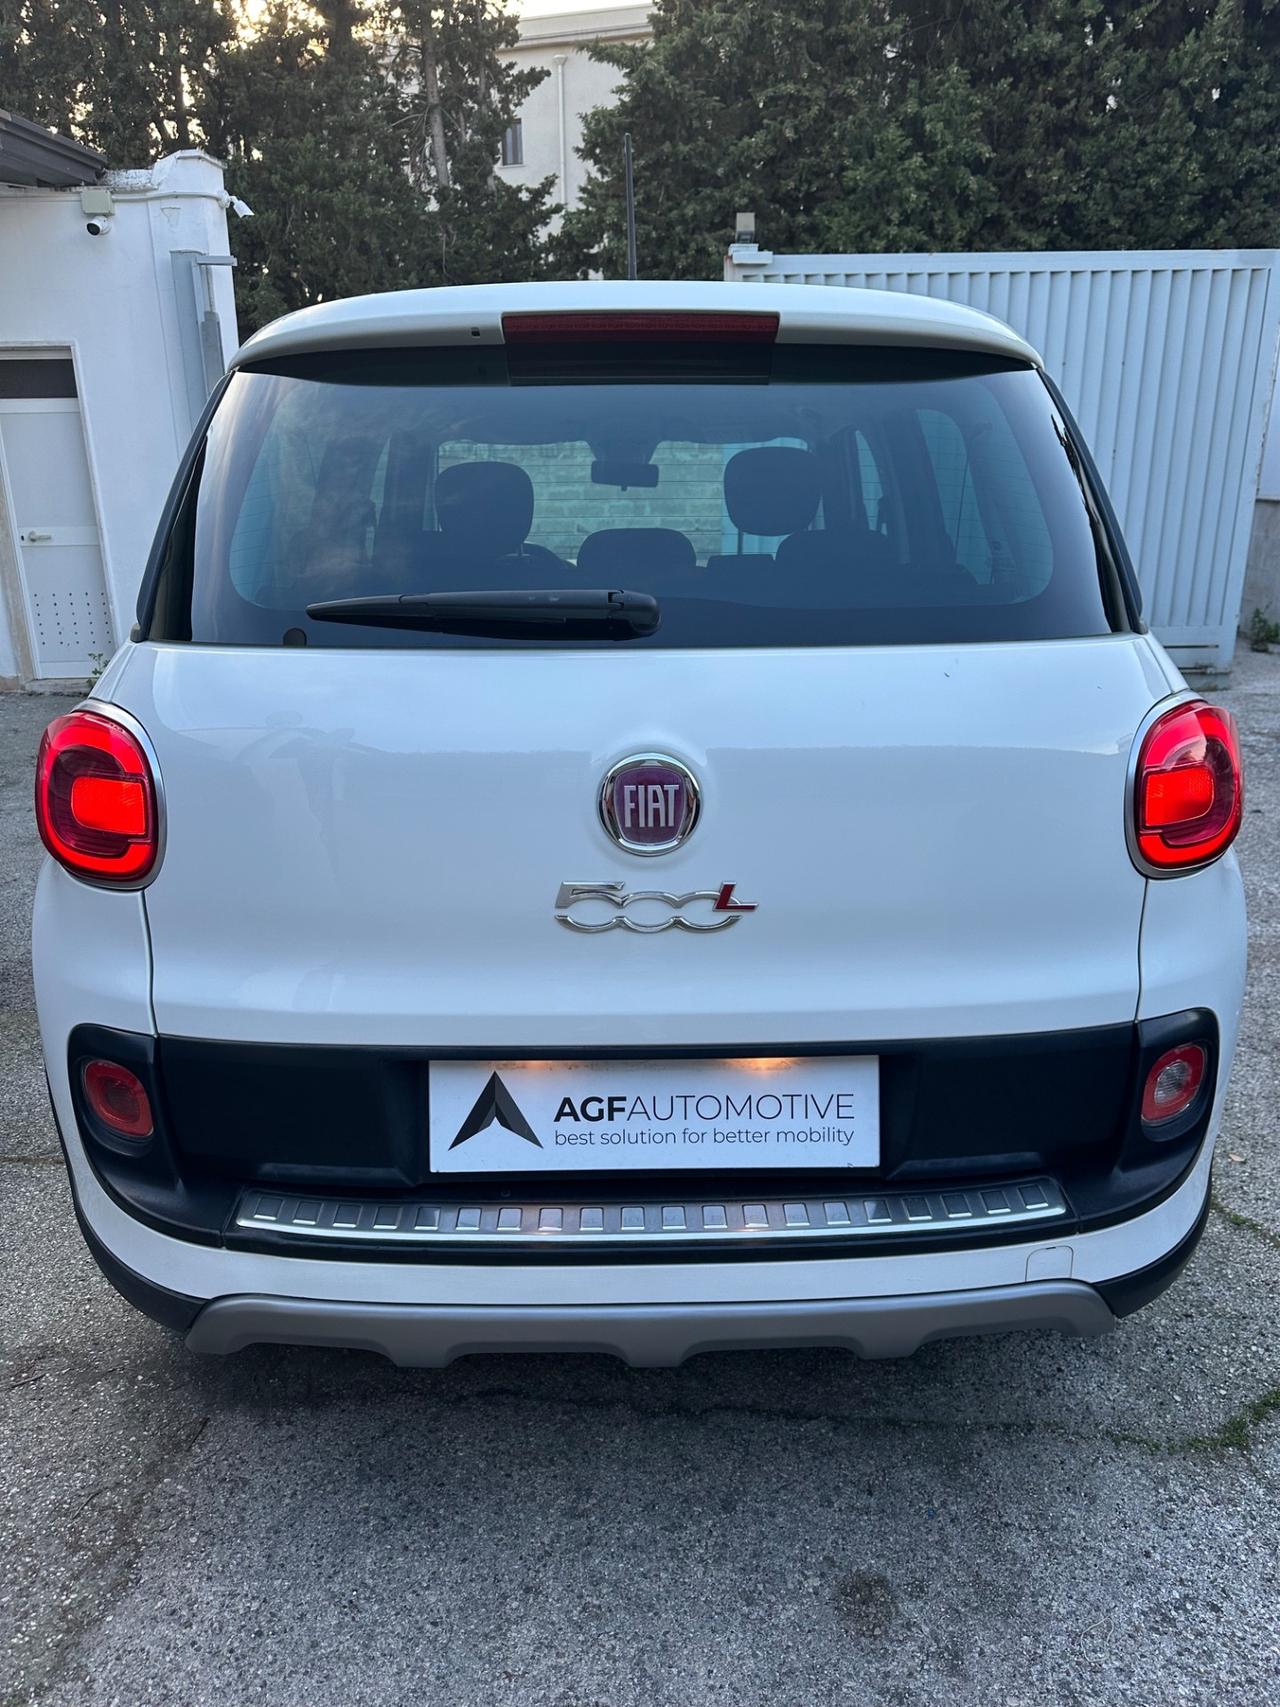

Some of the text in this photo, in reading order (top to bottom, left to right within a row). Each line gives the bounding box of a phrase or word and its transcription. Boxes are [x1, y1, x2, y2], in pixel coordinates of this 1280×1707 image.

[623, 784, 680, 828] FIAT
[554, 1125, 855, 1146] best solution for better mobility
